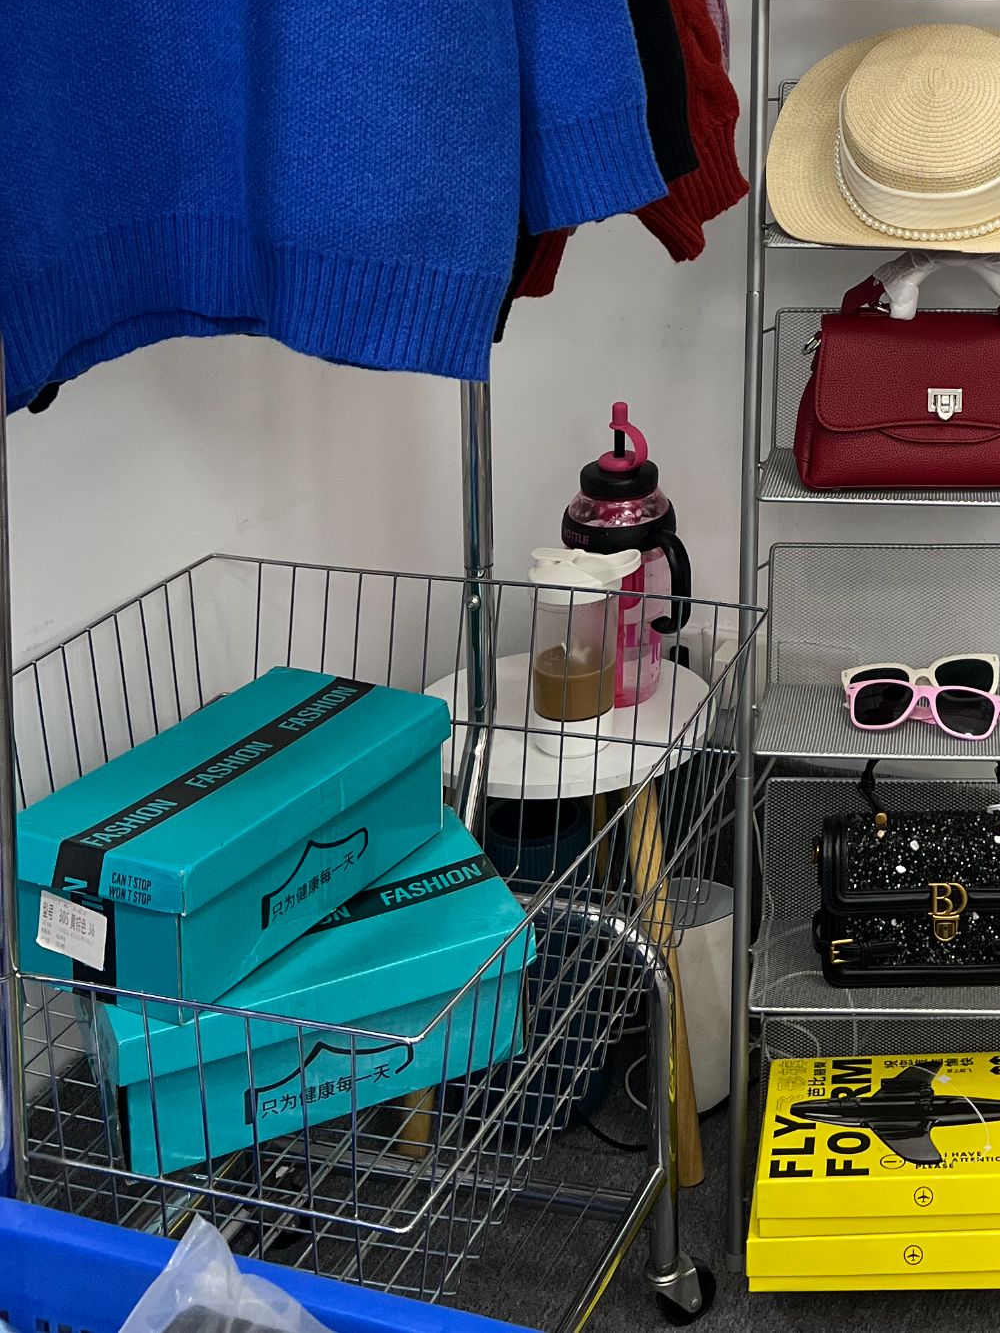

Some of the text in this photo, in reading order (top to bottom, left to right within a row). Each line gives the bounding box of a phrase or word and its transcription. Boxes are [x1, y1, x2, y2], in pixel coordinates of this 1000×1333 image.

[80, 685, 358, 847] FASHION FASHION FASHION
[132, 890, 152, 905] STOP
[133, 877, 152, 892] STOP
[380, 862, 483, 906] FASHION
[769, 1114, 817, 1179] FLY
